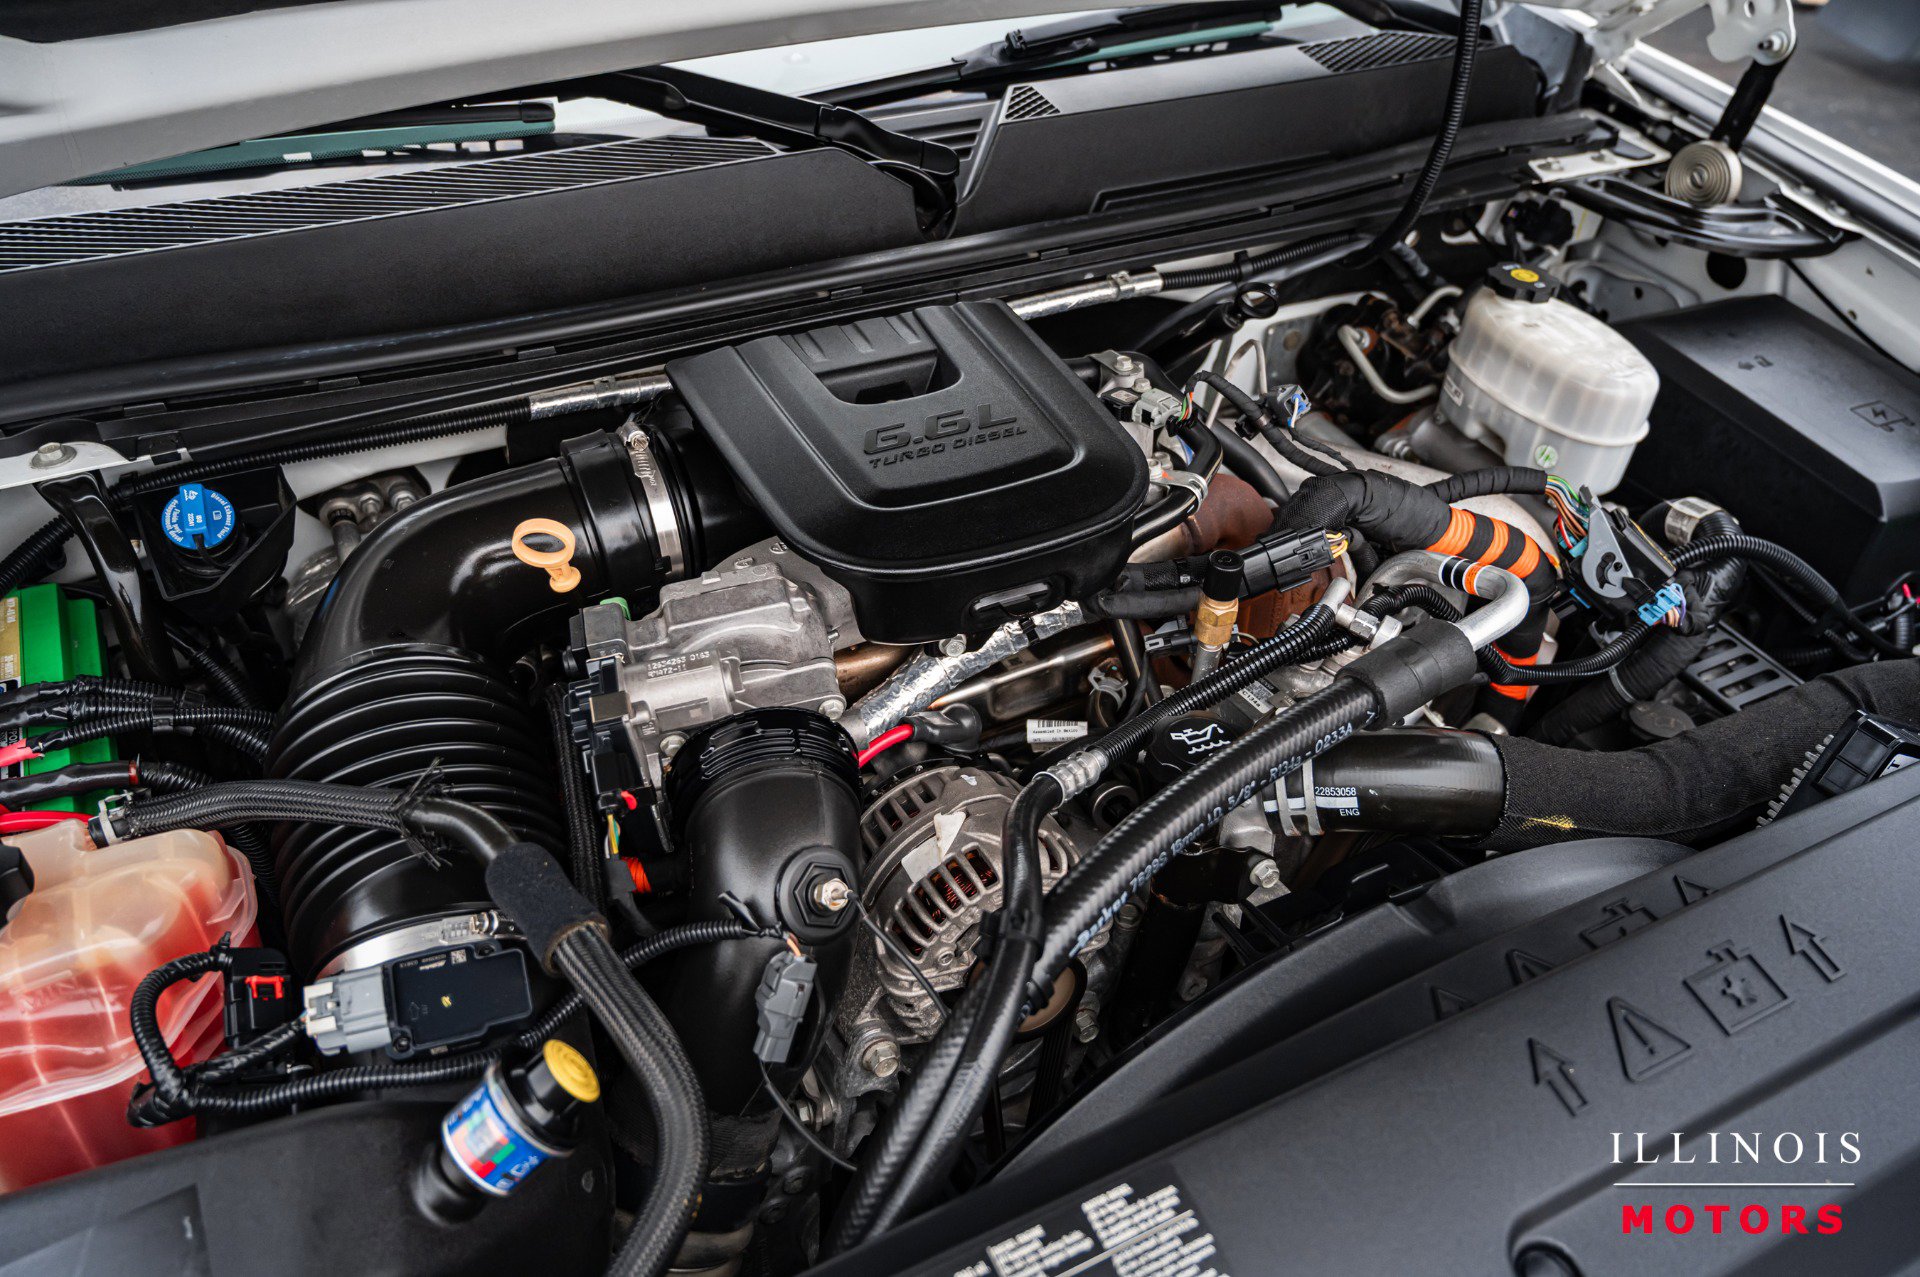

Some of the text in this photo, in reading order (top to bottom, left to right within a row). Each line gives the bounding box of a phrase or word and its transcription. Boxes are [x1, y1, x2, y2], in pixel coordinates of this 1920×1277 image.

[863, 403, 1018, 455] 6.6L
[868, 425, 1028, 469] TURBO DIESEL
[224, 504, 233, 527] Exhaust
[1314, 786, 1357, 796] 22853058
[1339, 808, 1360, 816] ENG
